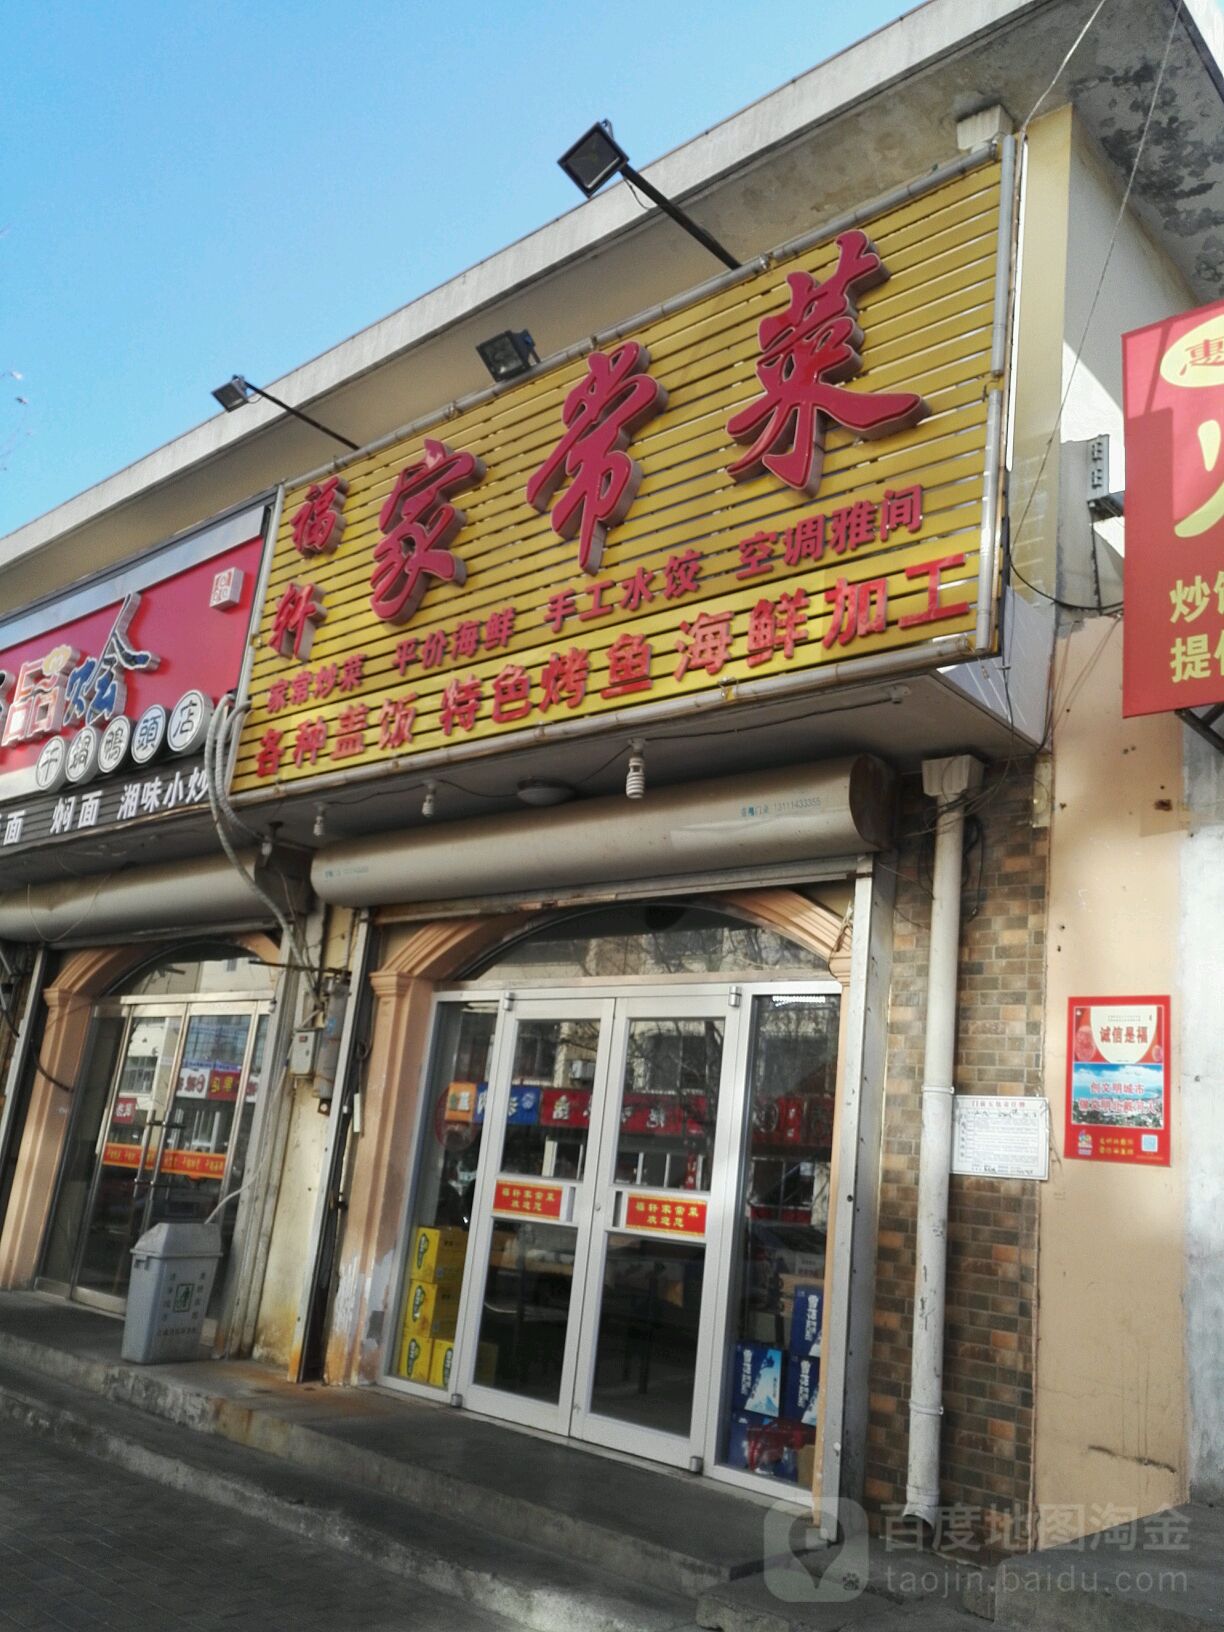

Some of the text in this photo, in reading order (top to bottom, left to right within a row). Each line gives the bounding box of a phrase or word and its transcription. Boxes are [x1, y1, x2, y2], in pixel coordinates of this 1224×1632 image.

[370, 229, 928, 622] 家常菜
[255, 552, 970, 777] 各种盖饭 特色烤鱼 海鲜加工
[267, 484, 923, 713] 家常炒菜 平价海鲜 手工水饺 空调雅间
[1170, 629, 1224, 683] 提
[0, 766, 209, 846] 面 焖面 湘味小炒
[1100, 1026, 1148, 1043] 诚信是福
